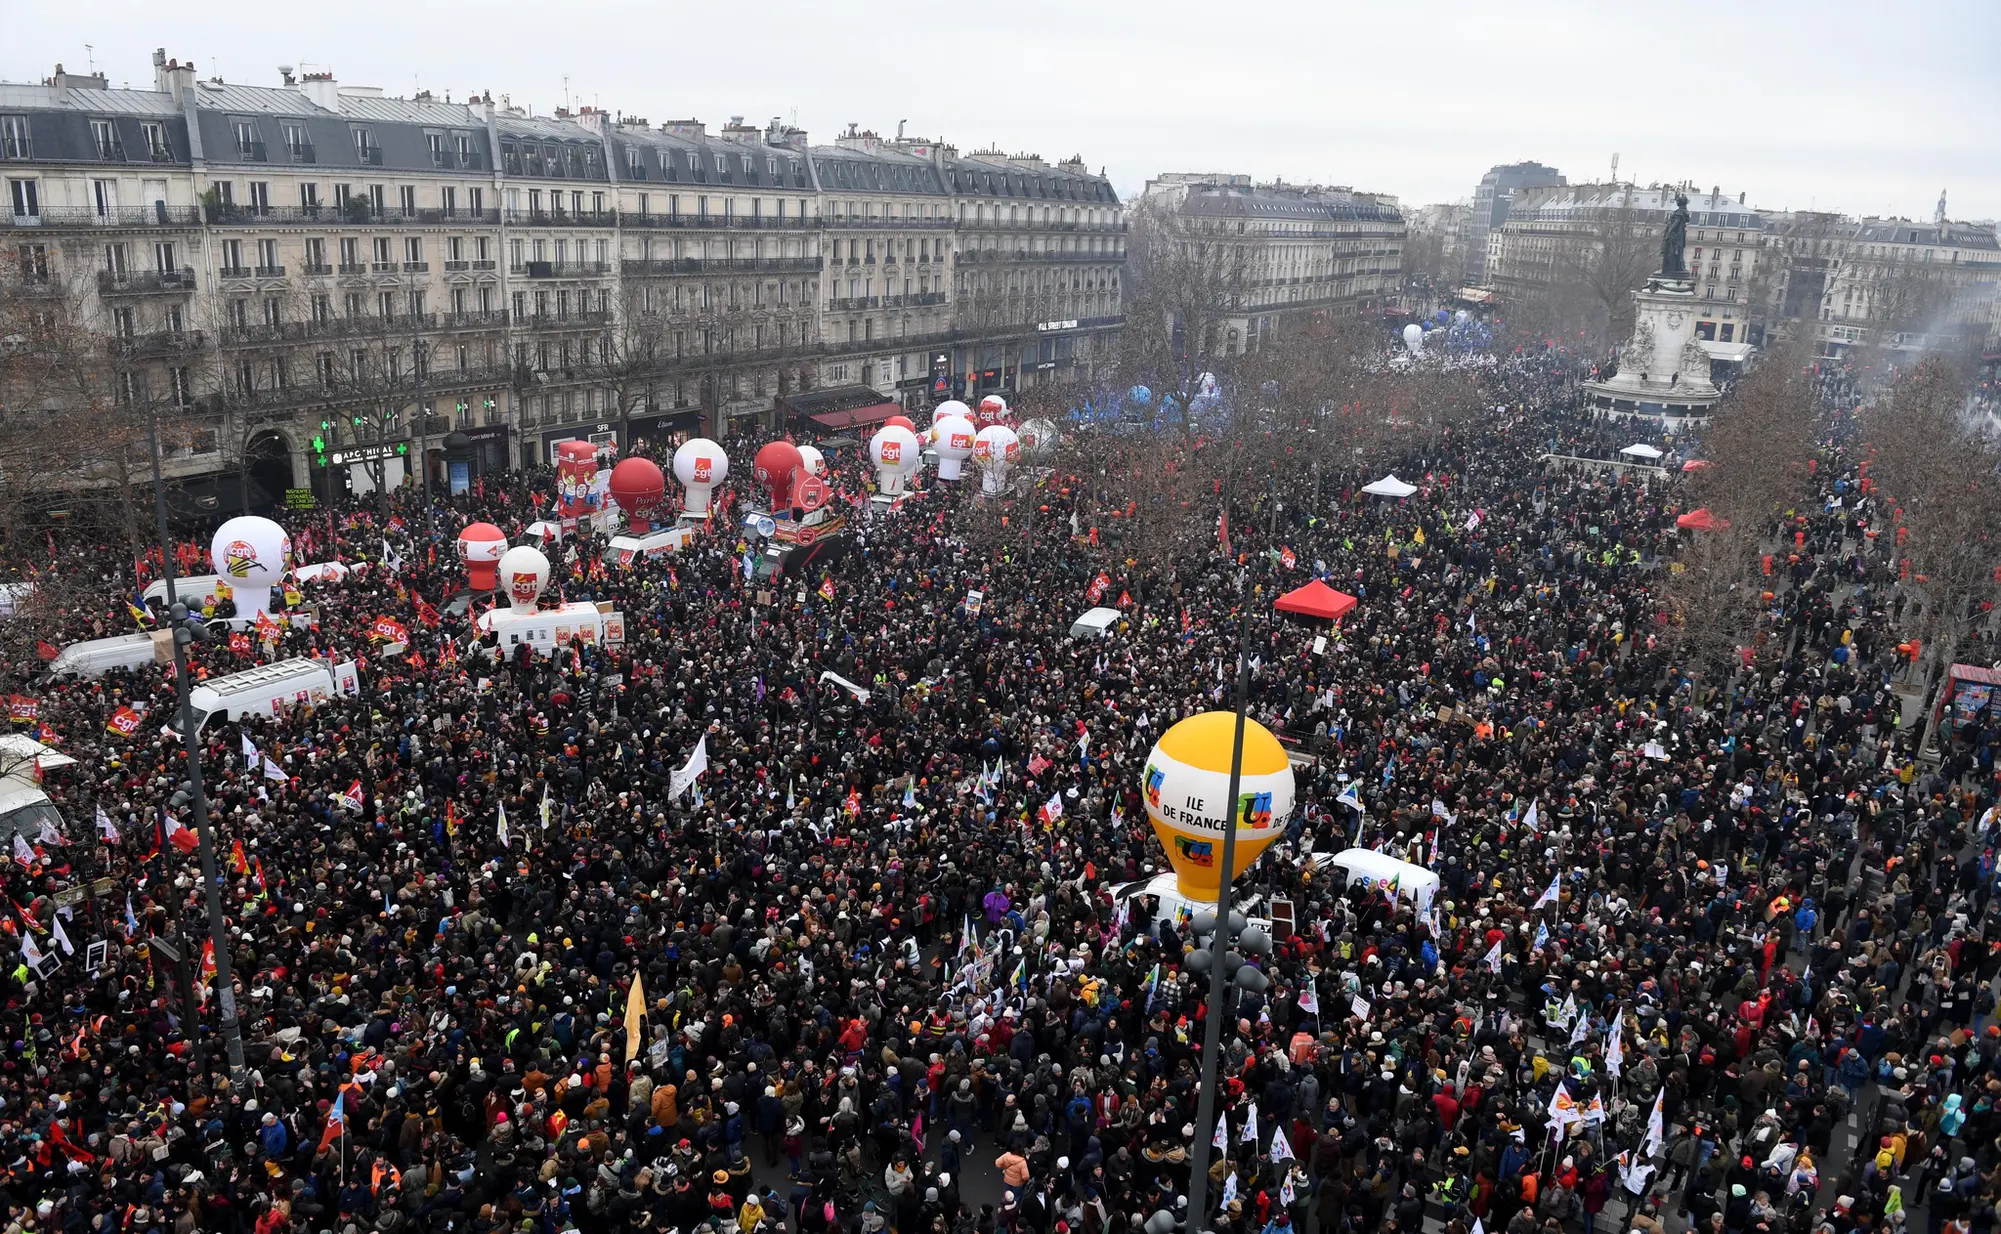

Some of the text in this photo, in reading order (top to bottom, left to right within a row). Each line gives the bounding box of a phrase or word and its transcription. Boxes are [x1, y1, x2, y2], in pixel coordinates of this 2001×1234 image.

[980, 411, 994, 421] cgt
[597, 423, 609, 432] SFR
[953, 439, 966, 448] cgt
[882, 446, 900, 460] cgt
[694, 467, 711, 479] cgt
[635, 508, 652, 519] cgt
[513, 580, 538, 594] cgt
[377, 623, 396, 635] cgt
[114, 715, 139, 732] cgt
[1186, 796, 1204, 812] ILE
[1163, 804, 1227, 831] DE FRANCE
